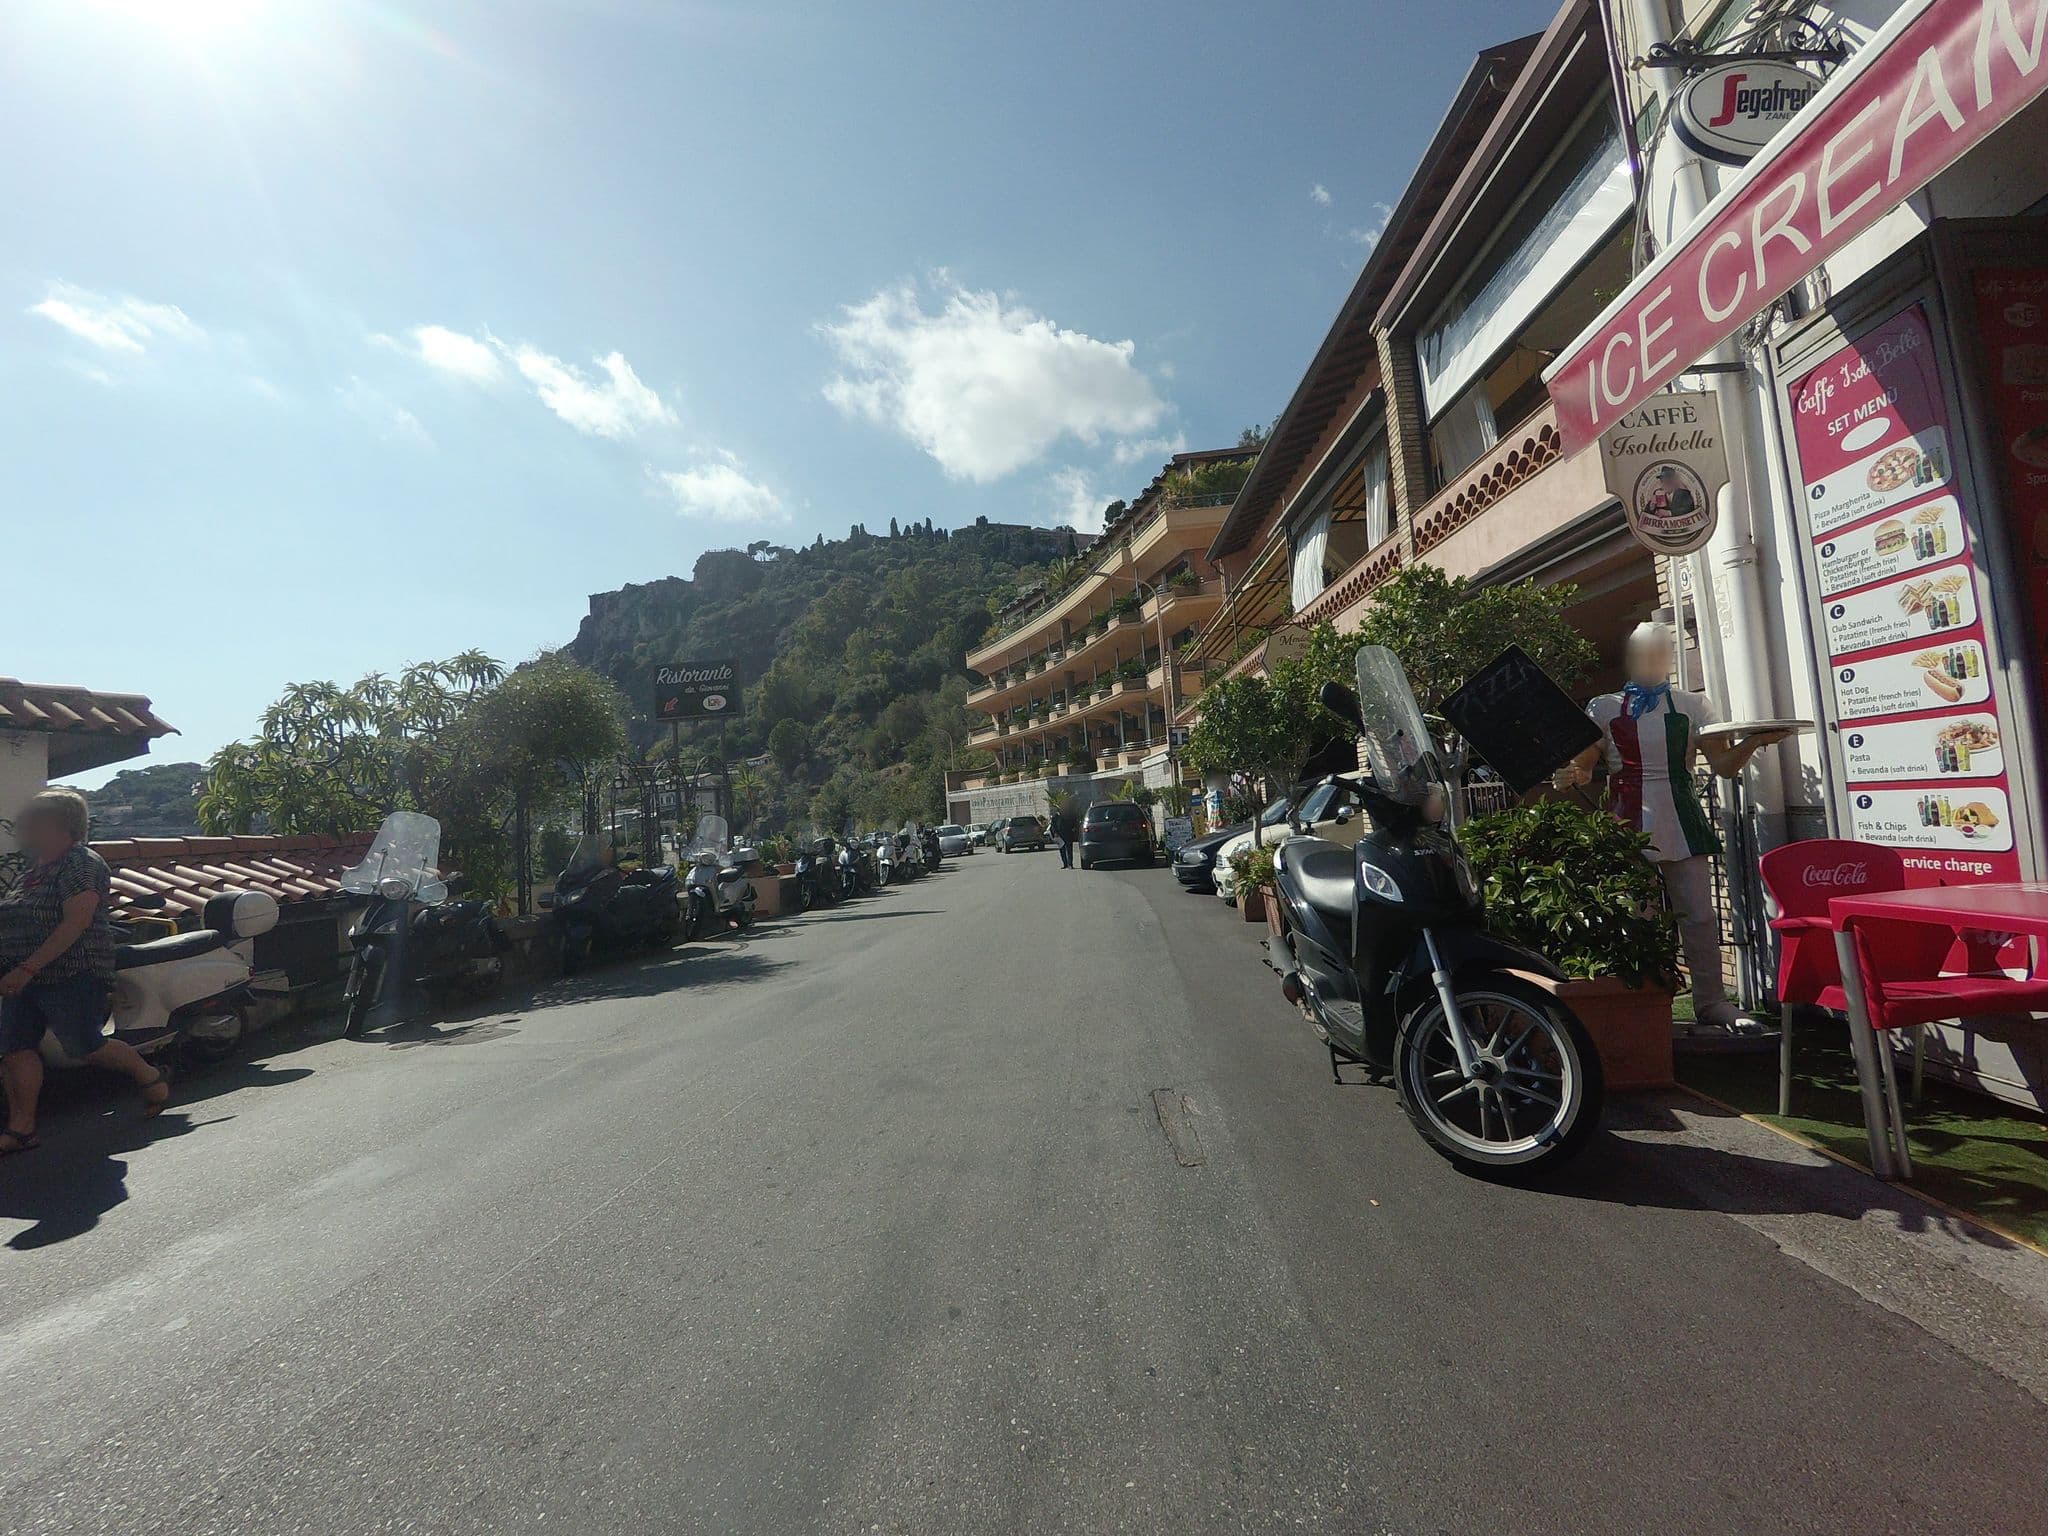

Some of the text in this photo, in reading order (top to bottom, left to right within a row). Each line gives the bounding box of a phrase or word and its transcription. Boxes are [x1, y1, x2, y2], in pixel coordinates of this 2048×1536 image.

[1709, 74, 1818, 127] Segafred
[1588, 285, 1677, 426] ICE
[1839, 355, 1875, 388] Isola
[1620, 400, 1697, 429] CAFFÈ
[1827, 413, 1851, 437] SET
[1609, 430, 1713, 457] Isolabella
[1814, 492, 1871, 520] Pizza Margherita
[1821, 511, 1850, 528] Bevanda
[1866, 497, 1886, 509] drink)
[1822, 551, 1859, 569] Hamburger
[1823, 556, 1872, 577] Chickenburger
[1830, 569, 1858, 582] Patatine
[1831, 577, 1860, 591] Bevanda
[1832, 614, 1883, 634] Club Sandwich
[1839, 630, 1868, 642] Patatine
[1840, 639, 1870, 652] Bevanda
[1888, 630, 1908, 642] drink)
[656, 663, 734, 685] Ristorante
[1840, 686, 1869, 697] Hot Dog
[1847, 695, 1878, 706] Patatine
[1849, 705, 1880, 715] Bevanda
[1898, 699, 1918, 709] drink)
[1853, 736, 1860, 746] E
[1850, 754, 1870, 762] Pasta
[1857, 765, 1889, 775] Bevanda
[1907, 763, 1928, 773] drink)
[1861, 796, 1868, 807] F
[1858, 822, 1907, 833] Fish & Chips
[1865, 833, 1897, 842] Bevanda
[1915, 834, 1936, 844] drink)
[1802, 862, 1867, 887] Coca-Cola
[1903, 856, 1992, 876] ervice charge
